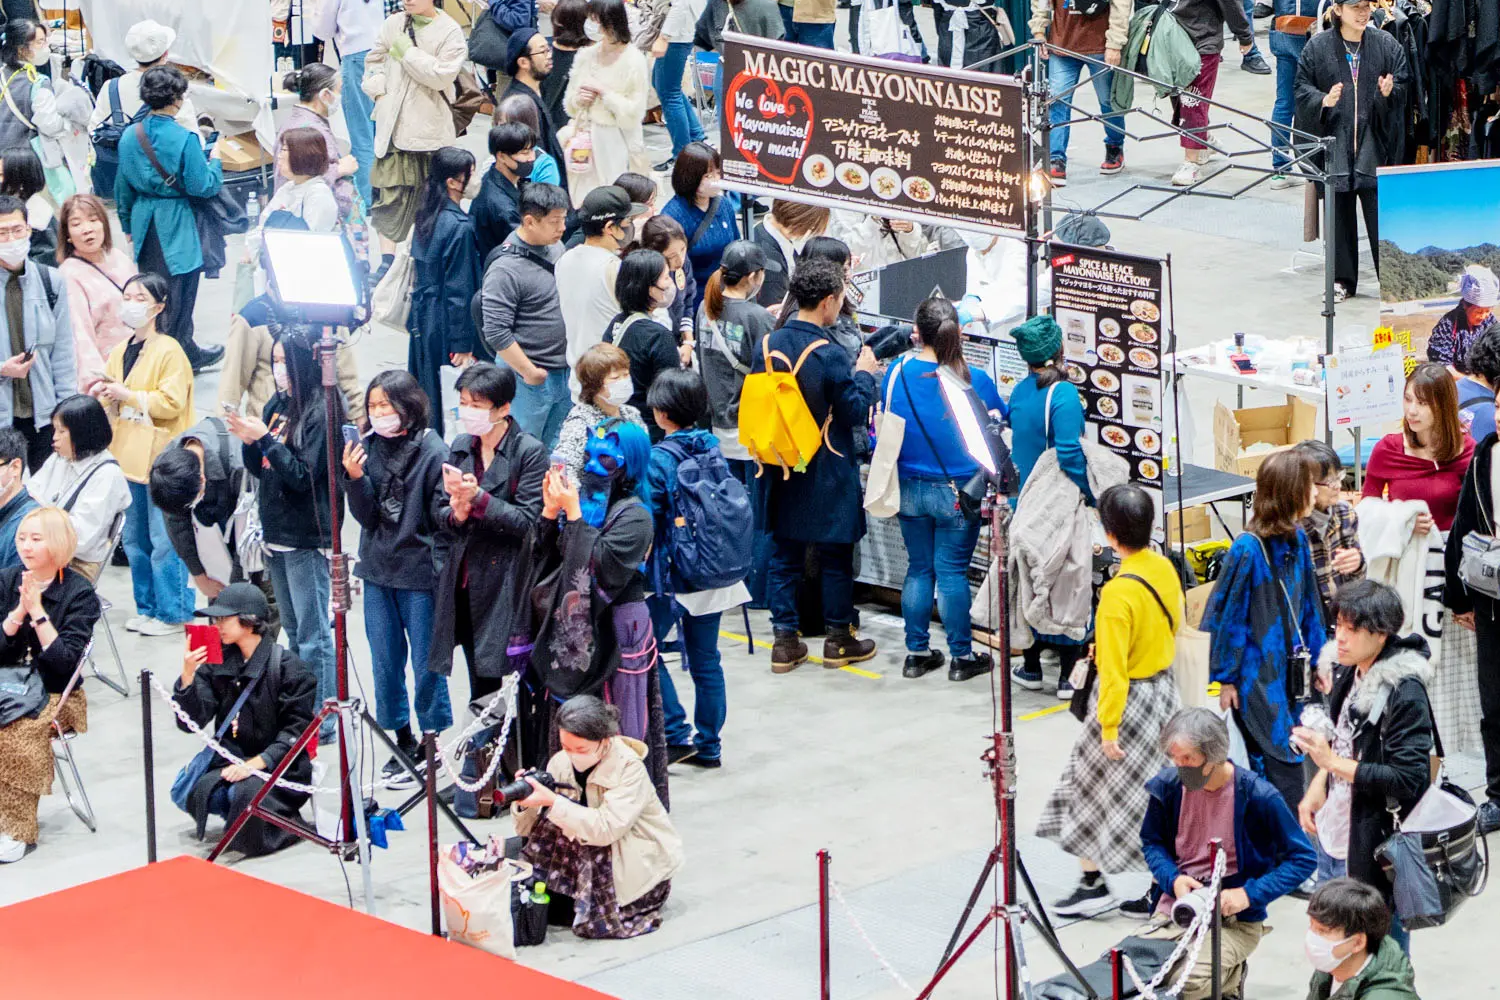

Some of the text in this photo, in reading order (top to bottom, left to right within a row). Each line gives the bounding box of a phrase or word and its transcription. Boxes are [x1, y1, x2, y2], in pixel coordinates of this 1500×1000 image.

[742, 50, 1003, 117] MAGIC MAYONNAISE
[735, 91, 786, 114] We love
[734, 111, 811, 139] Mayonnaise!
[734, 131, 806, 160] Very much!
[831, 138, 911, 171] 万能調味料
[1063, 265, 1151, 287] MAYONNAISE FACTORY
[1079, 258, 1101, 271] SPICE
[1101, 262, 1109, 272] &
[1109, 263, 1134, 276] PEACE
